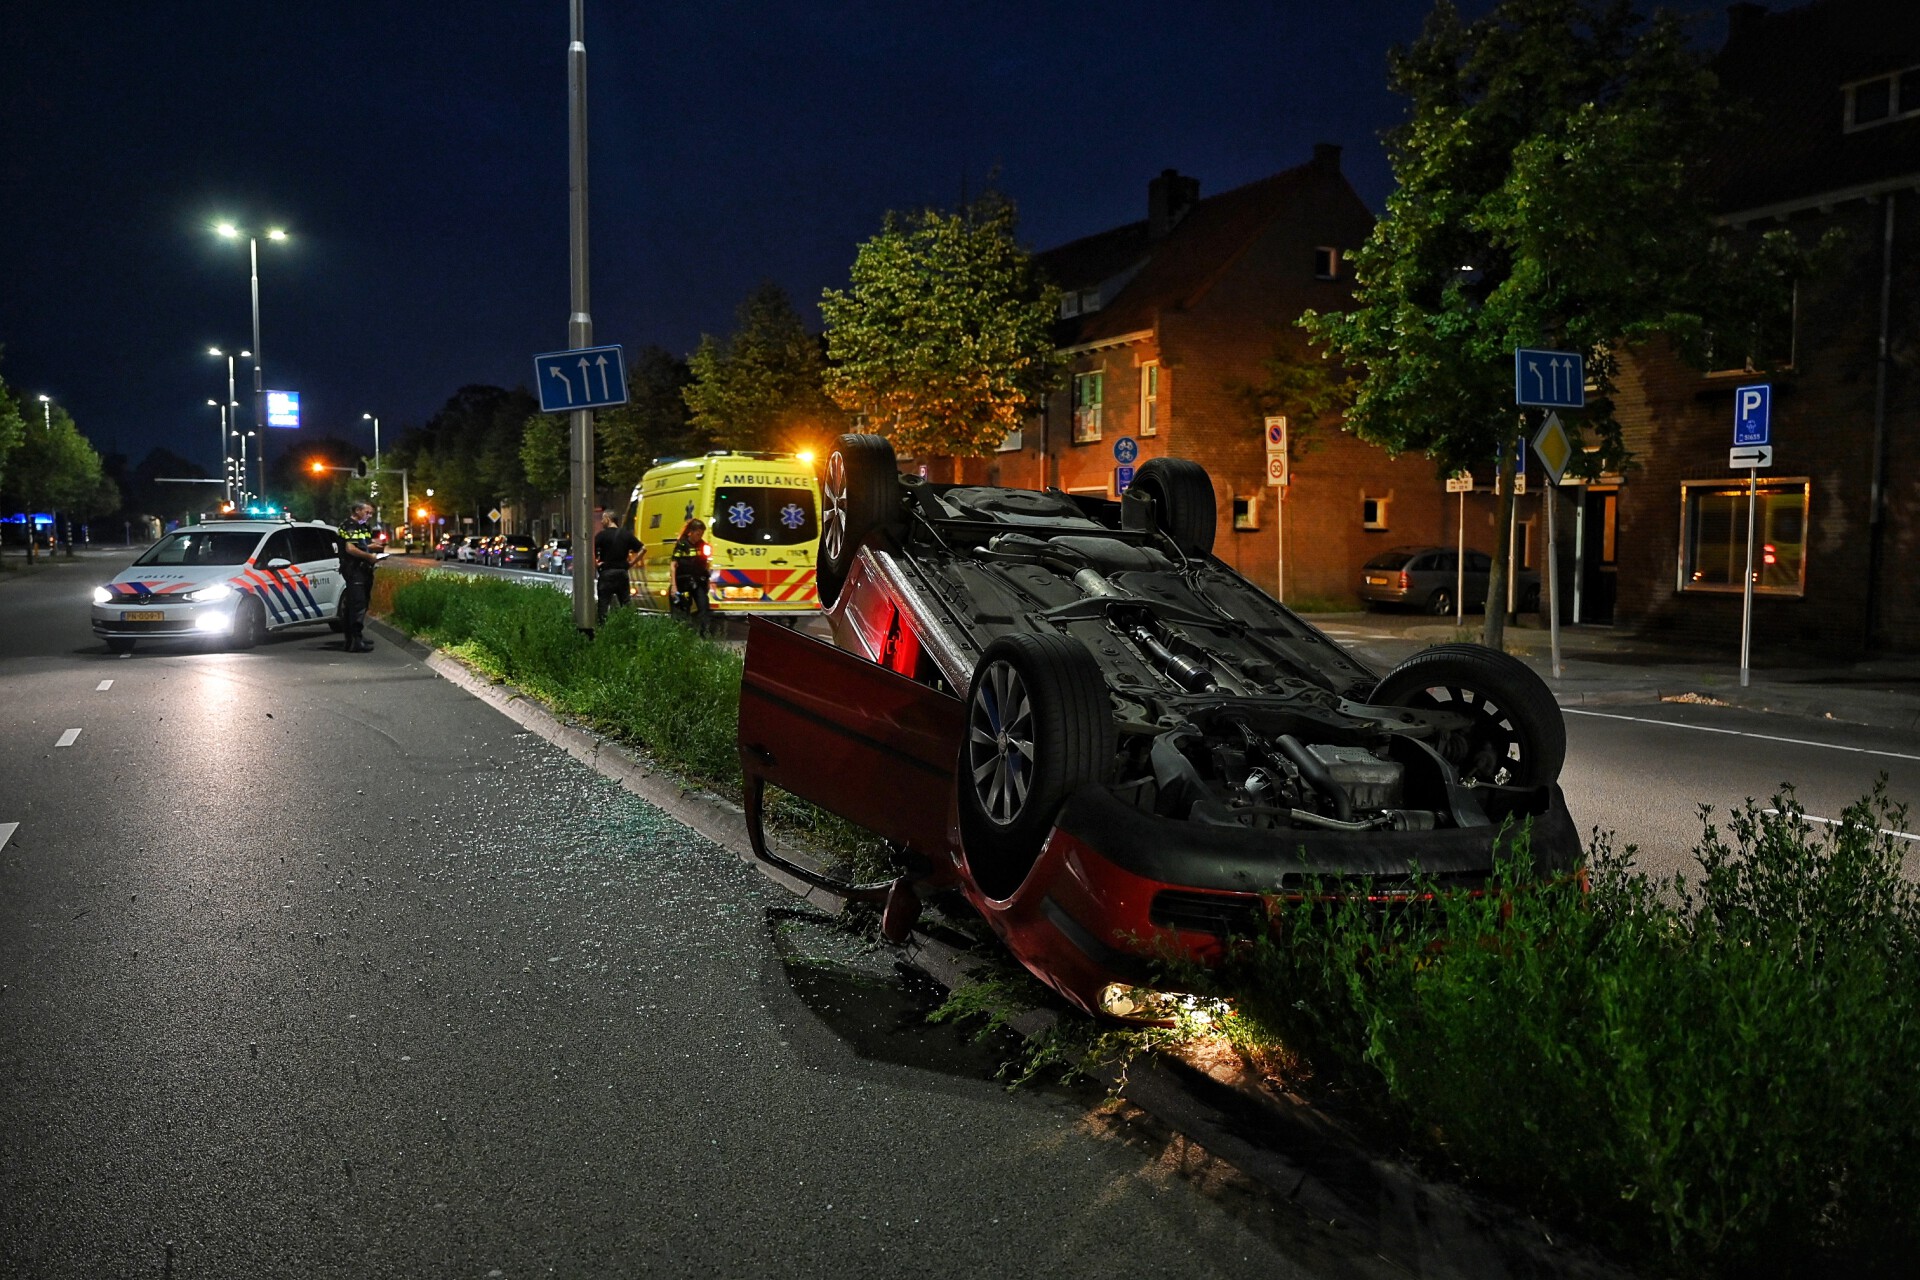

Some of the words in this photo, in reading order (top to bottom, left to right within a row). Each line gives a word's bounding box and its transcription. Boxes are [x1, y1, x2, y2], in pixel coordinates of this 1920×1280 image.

[1743, 392, 1761, 421] P
[1272, 465, 1281, 473] 30
[723, 475, 809, 487] AMBULANCE
[733, 548, 768, 557] 20-187
